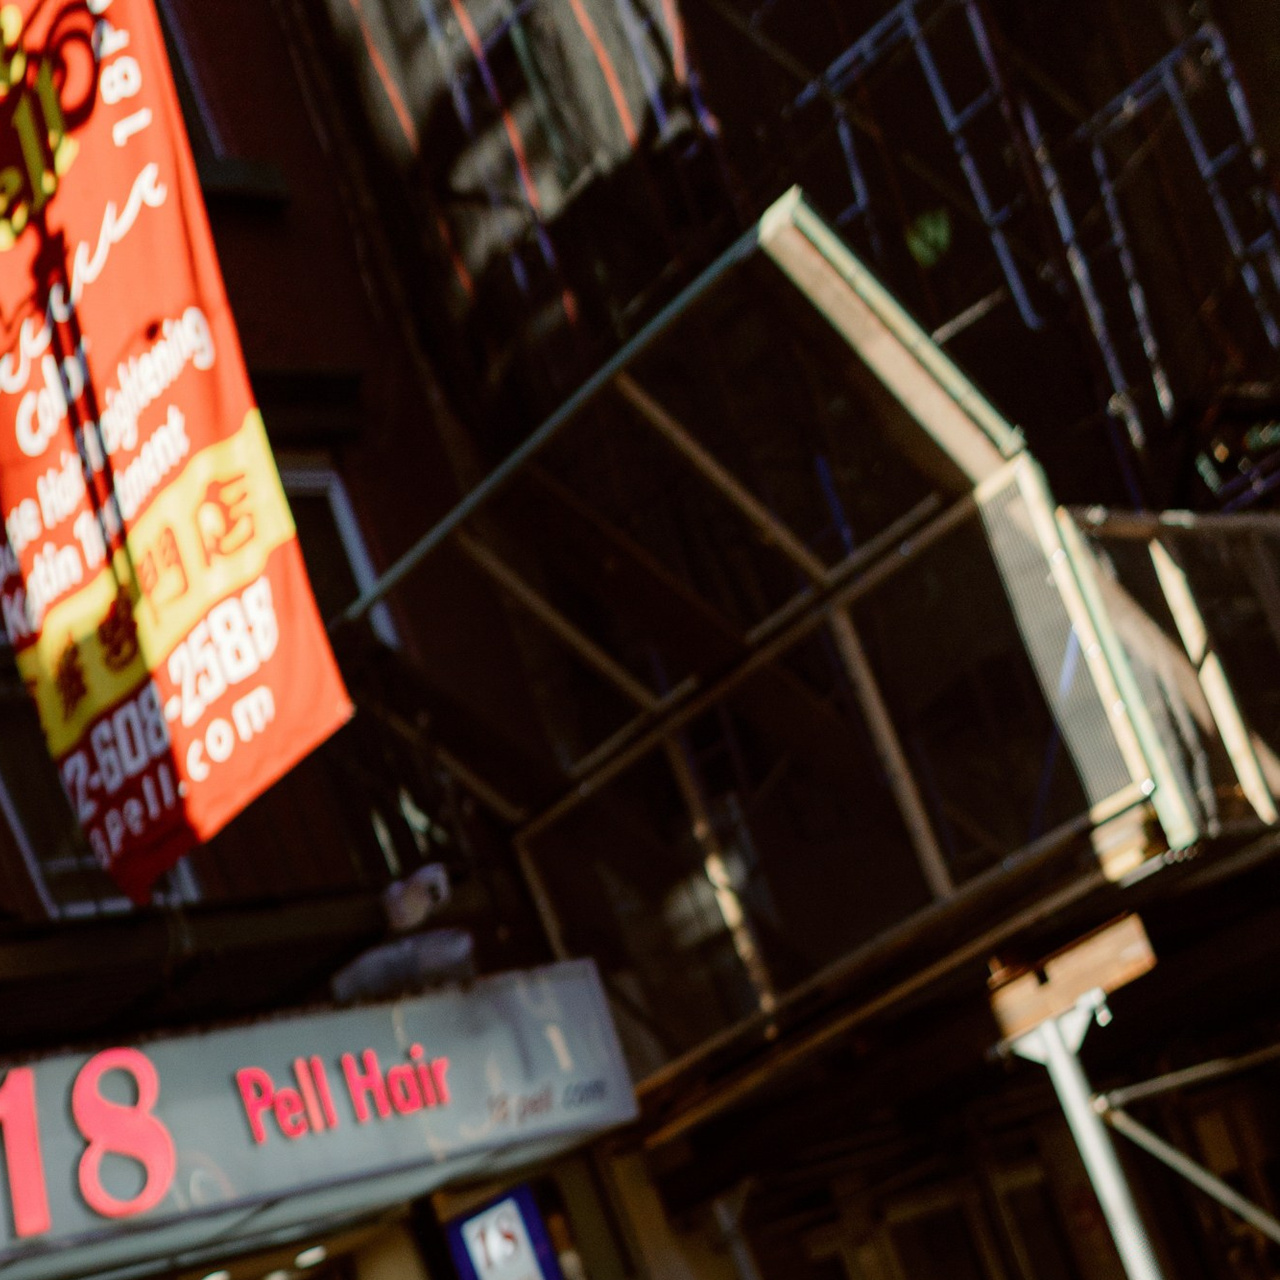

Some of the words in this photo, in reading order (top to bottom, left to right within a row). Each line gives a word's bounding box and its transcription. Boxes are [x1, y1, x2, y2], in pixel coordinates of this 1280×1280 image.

[61, 574, 282, 826] 2-608-2588
[235, 1054, 338, 1145] Pell
[339, 1042, 450, 1124] Hair
